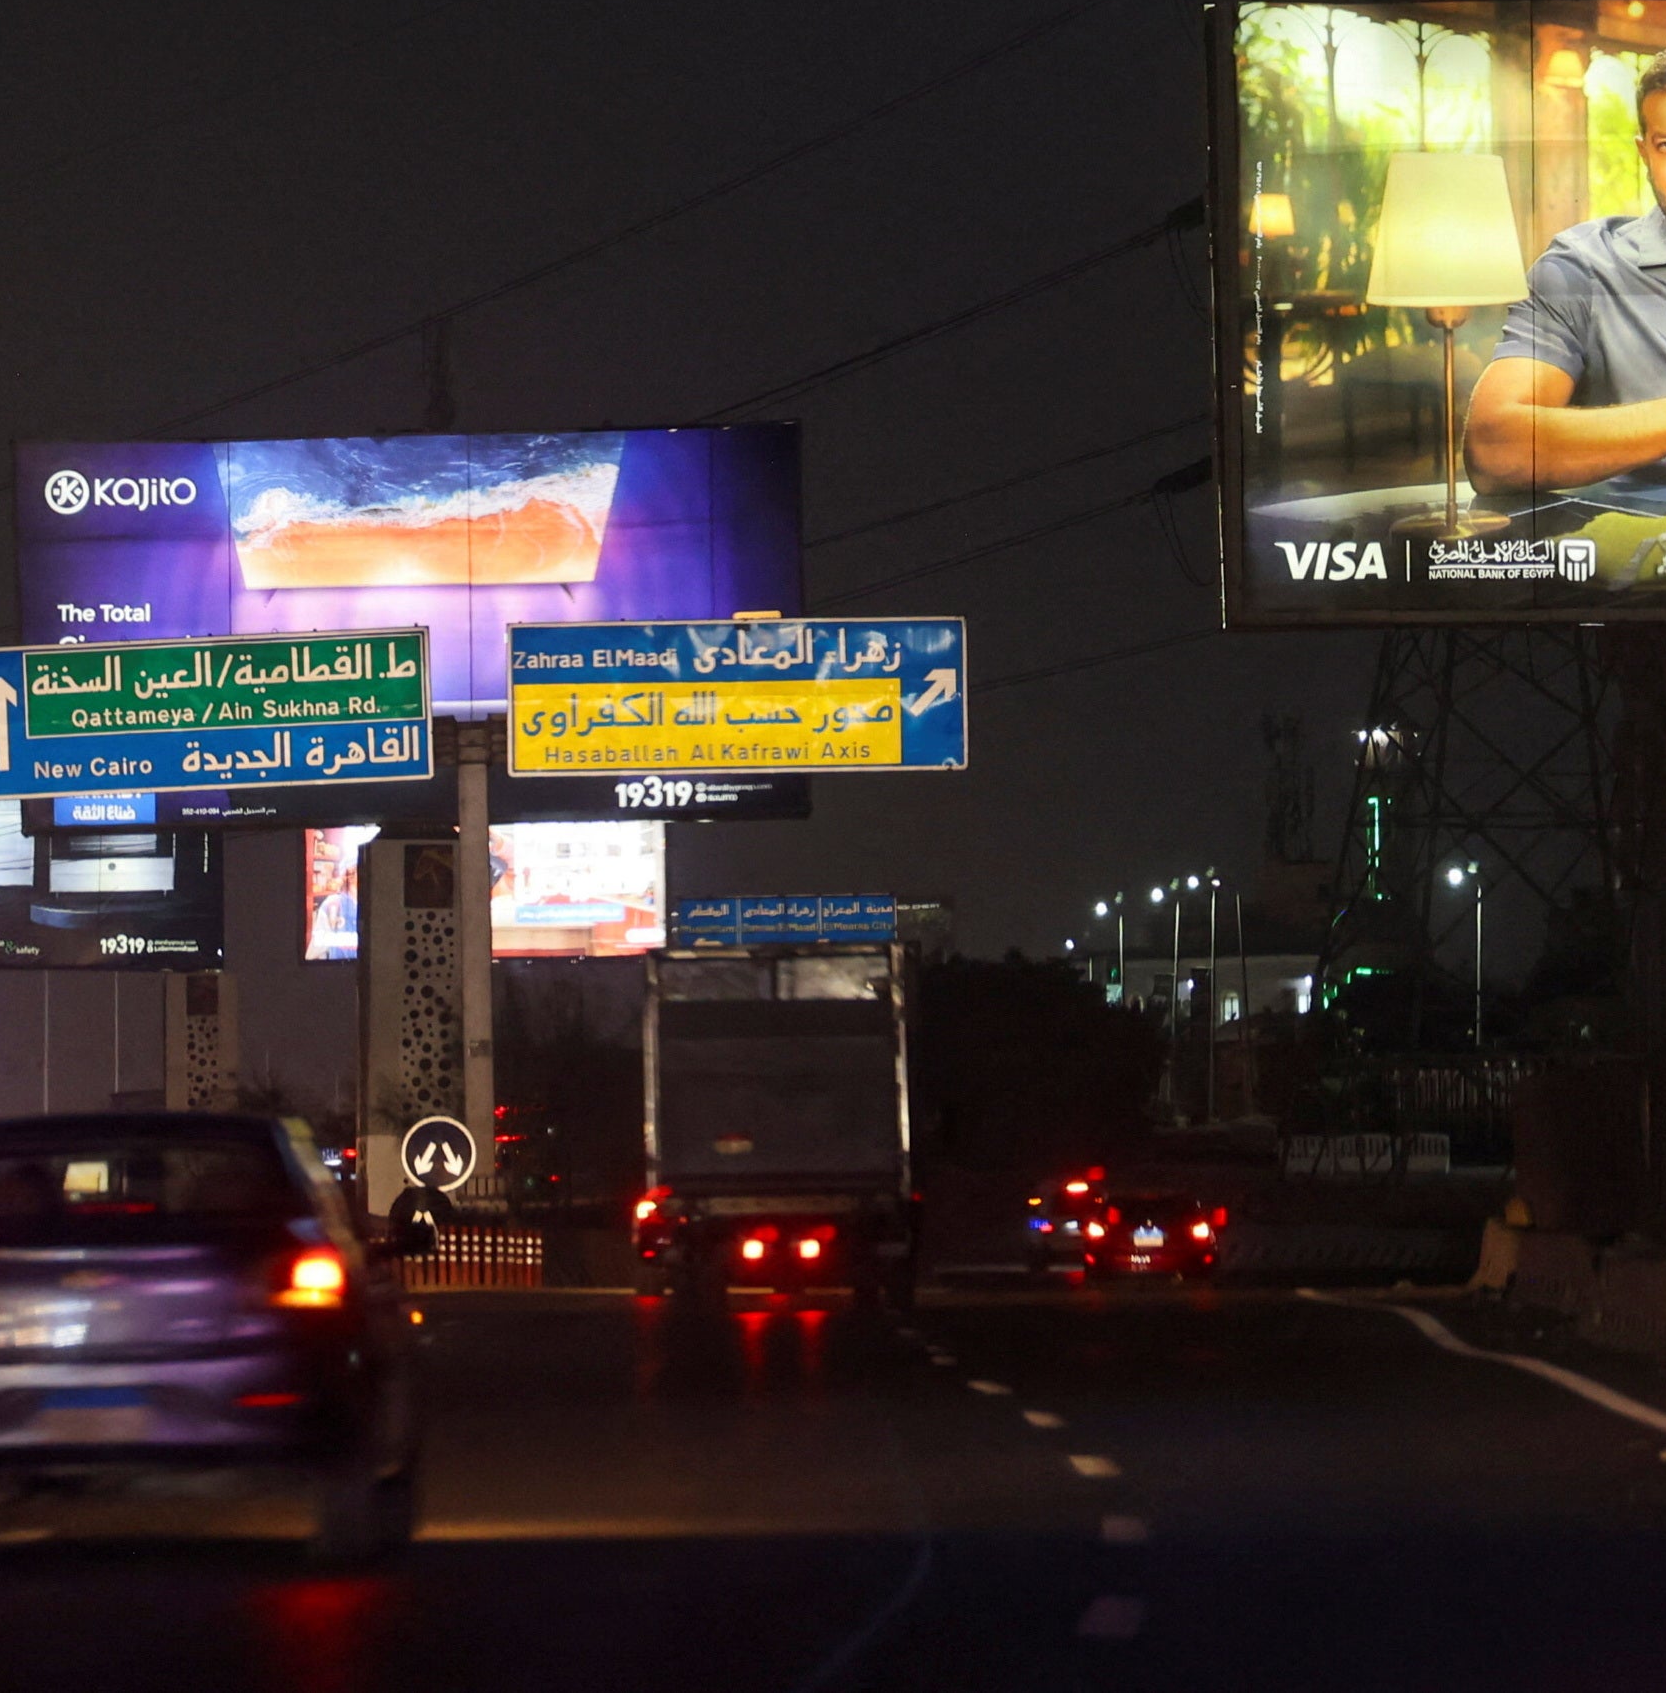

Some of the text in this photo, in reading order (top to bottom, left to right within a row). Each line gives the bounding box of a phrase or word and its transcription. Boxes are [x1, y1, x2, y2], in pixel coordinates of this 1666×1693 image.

[1274, 541, 1388, 581] VISA
[1429, 568, 1556, 580] NATIONAL BANK OF EGYPT
[57, 603, 151, 623] The Total
[513, 651, 584, 670] Zahraa
[822, 627, 902, 672] زهراء
[31, 654, 121, 697] السخنة
[70, 707, 195, 728] Qattameya
[218, 699, 253, 721] Ain
[262, 698, 340, 718] Sukhna
[348, 696, 382, 715] Rd.
[672, 691, 717, 726] الله
[724, 704, 802, 734] حسب
[811, 700, 894, 735] محور
[33, 756, 153, 780] New Cairo
[181, 725, 421, 780] القاهرة الجديدة
[544, 744, 679, 764] Hasaballah
[820, 742, 871, 760] Axis
[614, 775, 694, 808] 19319
[99, 933, 145, 954] 19319
